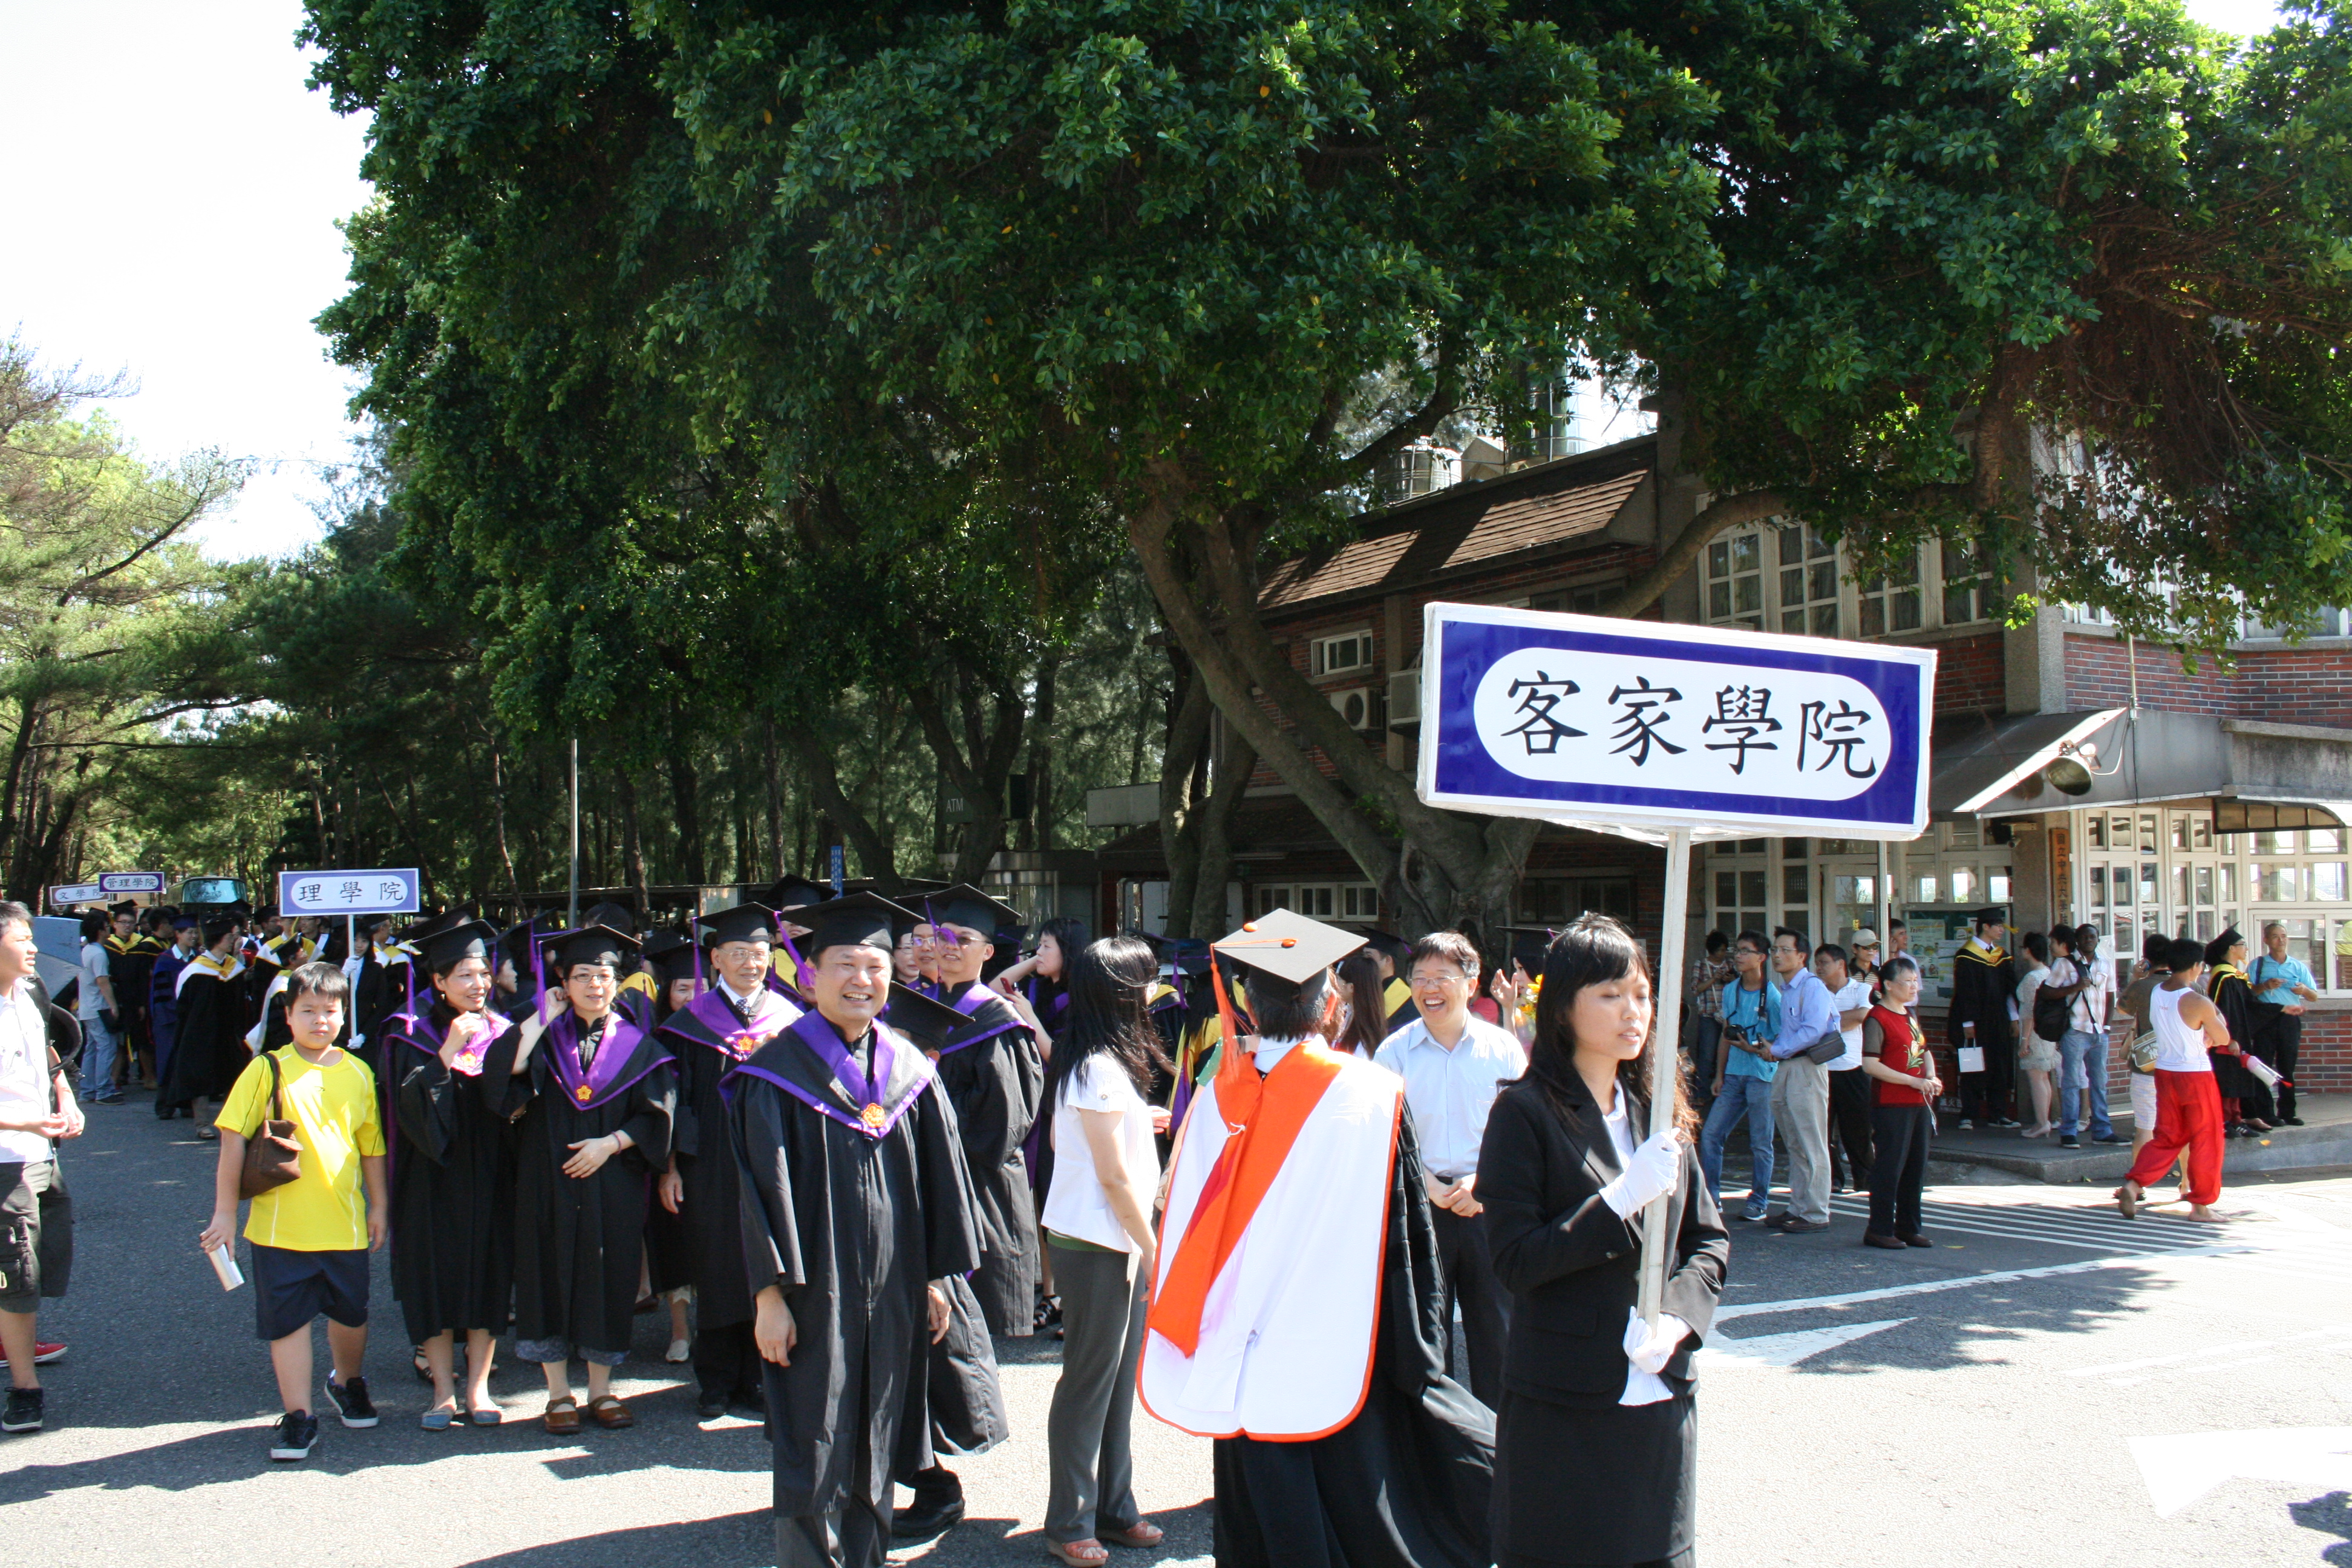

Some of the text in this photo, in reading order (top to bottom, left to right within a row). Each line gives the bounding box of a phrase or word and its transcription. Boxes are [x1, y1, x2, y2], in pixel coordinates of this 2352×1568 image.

[1500, 670, 1877, 779] 客家學院
[946, 799, 963, 812] ATM
[106, 877, 157, 888] 管理學院
[59, 889, 104, 900] 文學院
[298, 881, 404, 904] 理學院
